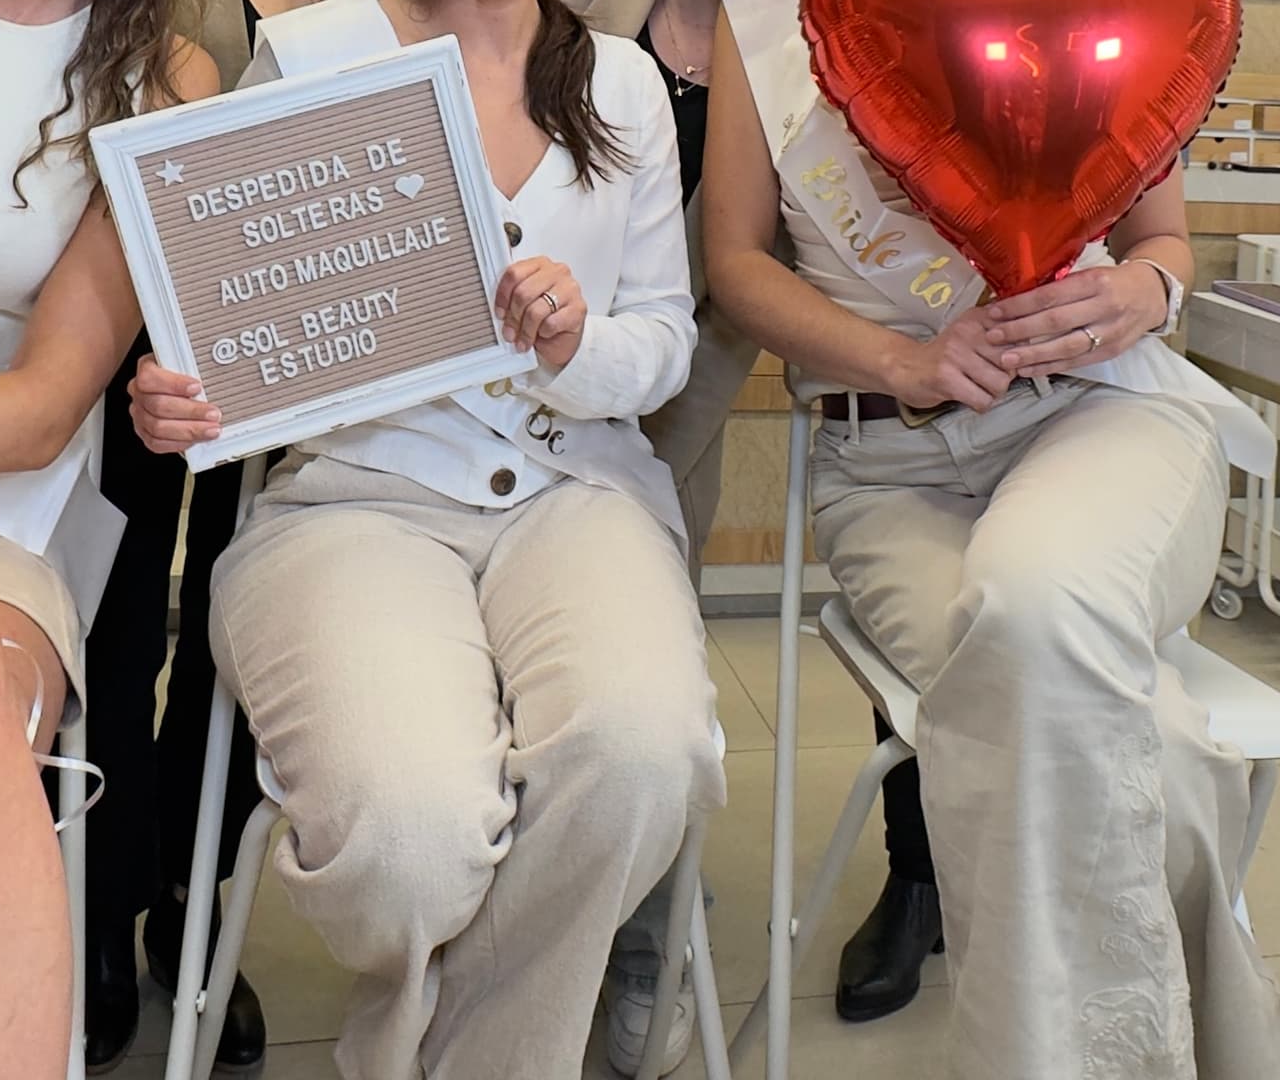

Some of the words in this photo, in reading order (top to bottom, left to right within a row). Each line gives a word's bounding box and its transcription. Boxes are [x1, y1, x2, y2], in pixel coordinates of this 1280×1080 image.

[187, 154, 350, 222] DESPEDIDA
[366, 138, 407, 172] DE
[242, 186, 384, 248] SOLTERAS
[219, 263, 289, 307] AUTO
[294, 217, 450, 284] MAQUILLAJE
[800, 155, 906, 270] Bride
[910, 256, 953, 308] to
[212, 322, 289, 365] @SOL
[300, 288, 399, 340] BEAUTY
[259, 328, 377, 386] ESTUDIO
